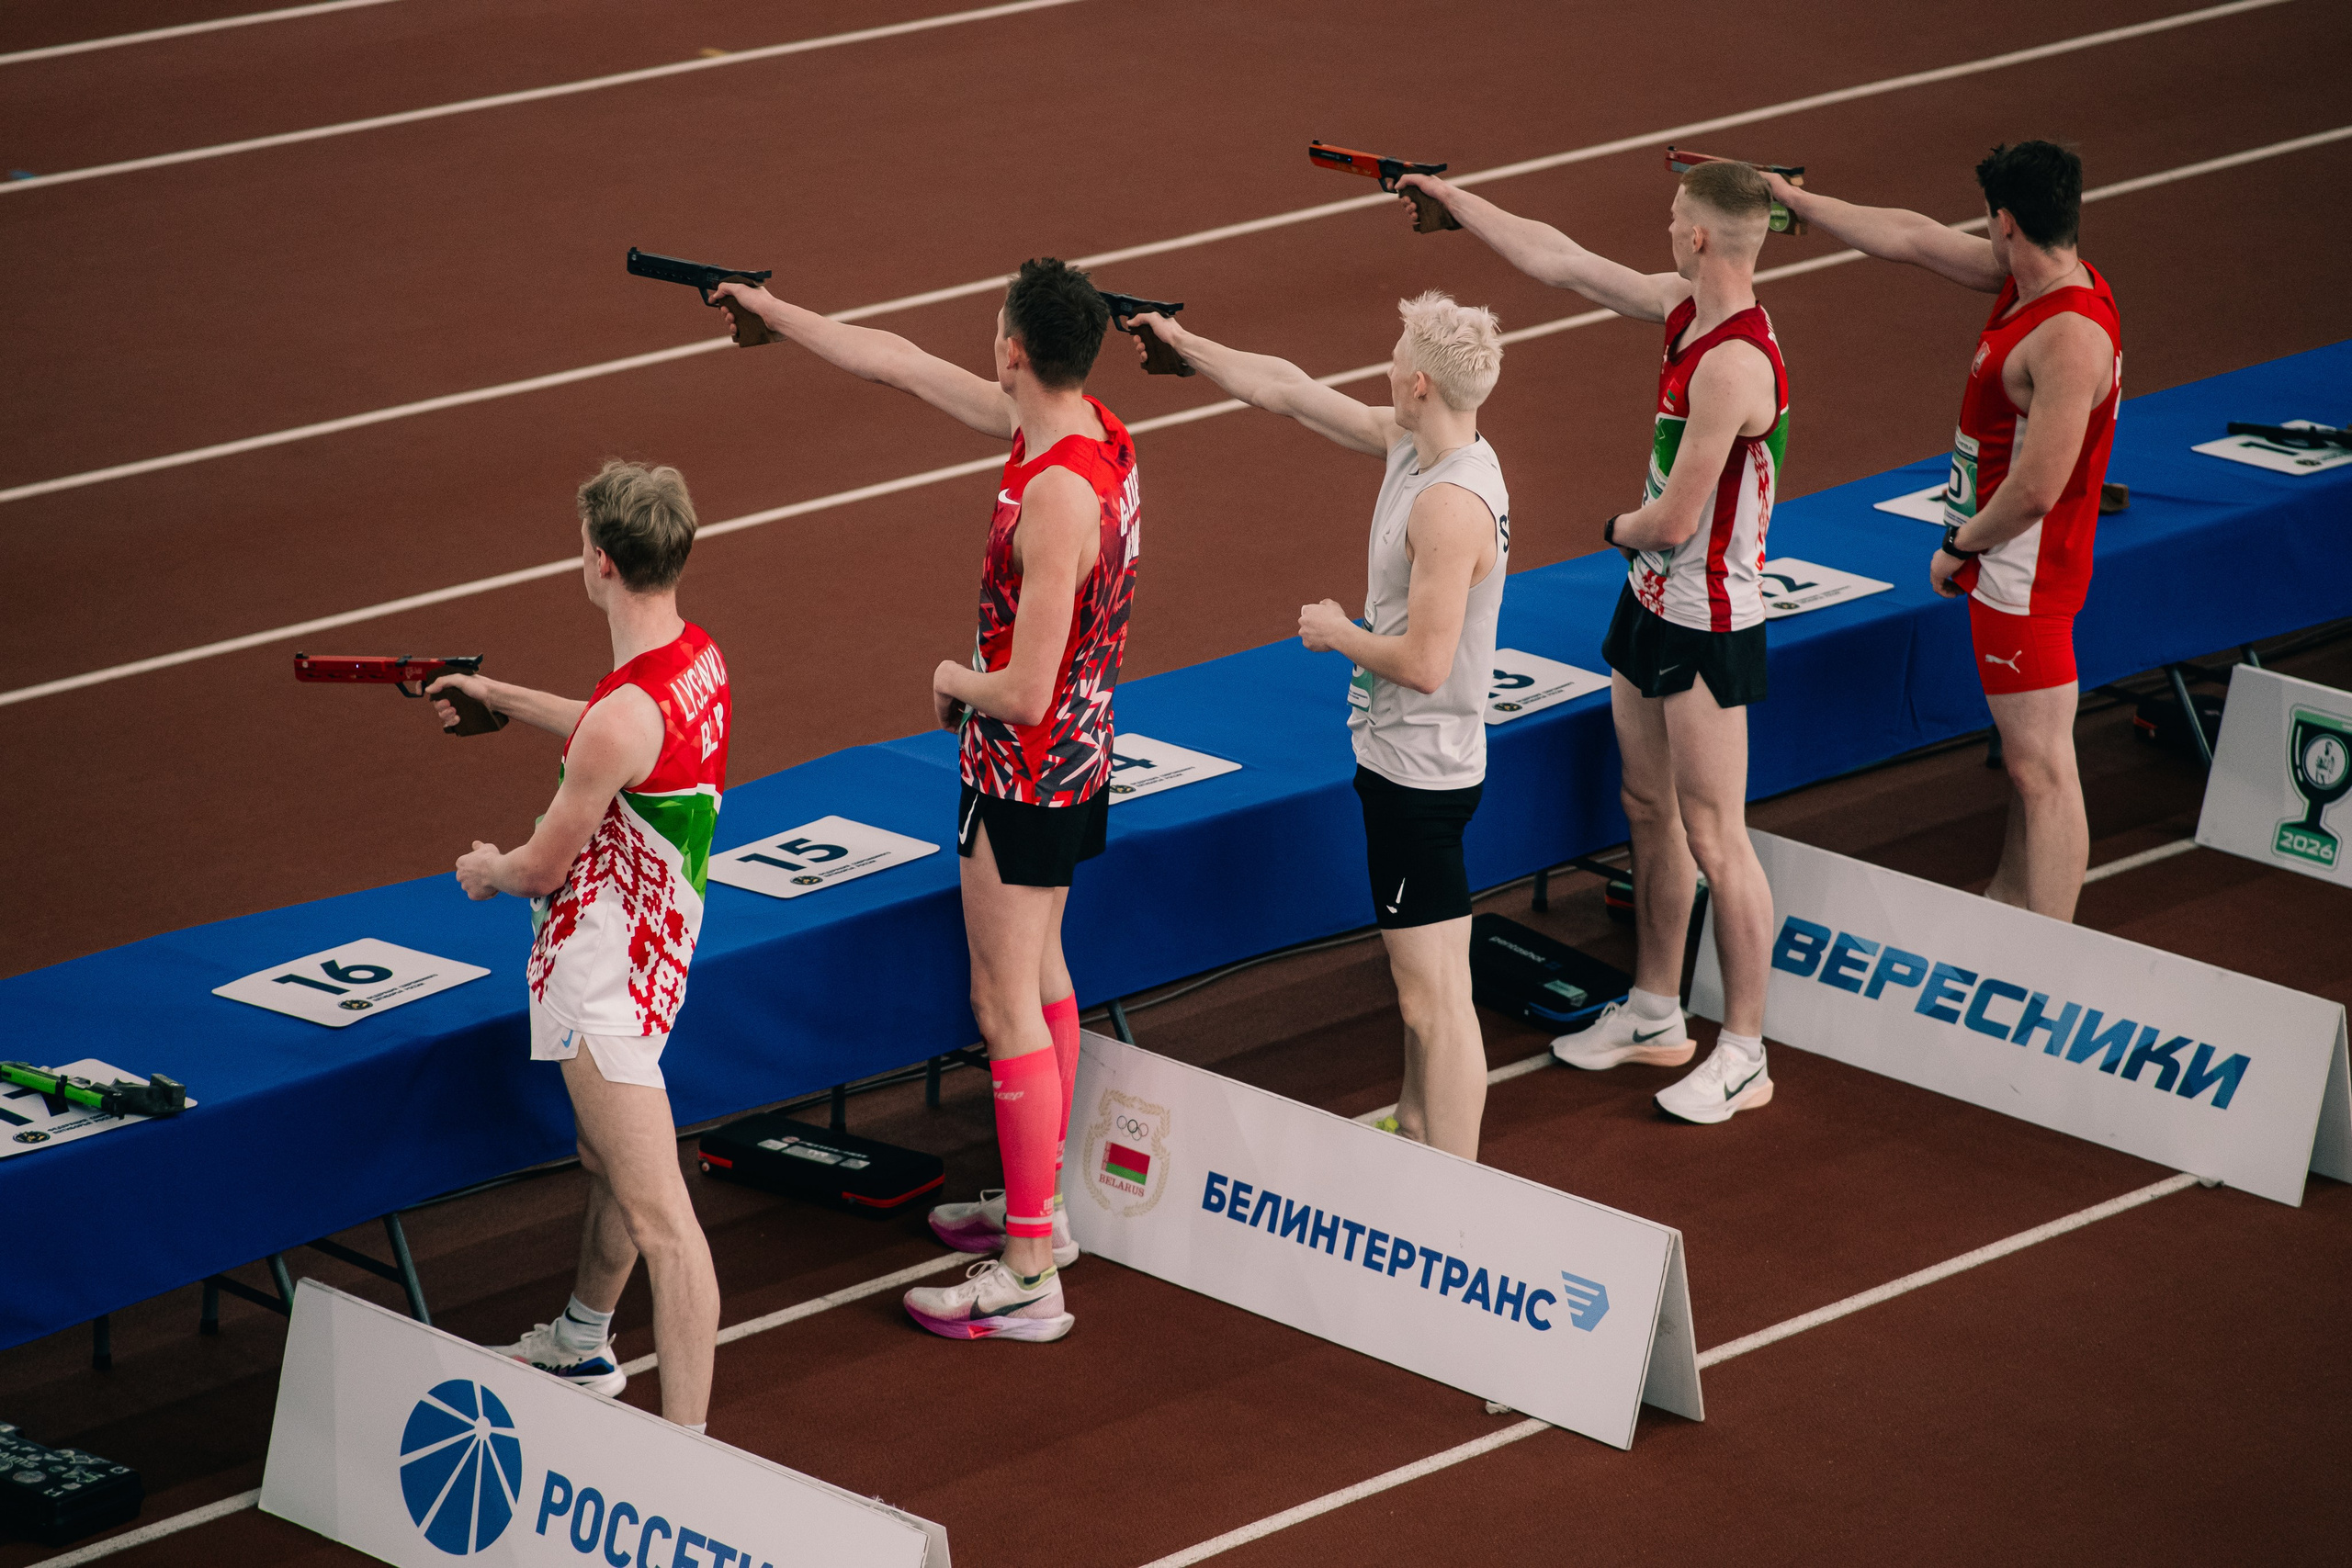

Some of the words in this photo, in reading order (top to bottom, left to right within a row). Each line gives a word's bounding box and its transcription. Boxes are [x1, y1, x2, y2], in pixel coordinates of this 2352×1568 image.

[1758, 573, 1819, 598] 2
[1110, 752, 1158, 780] 4
[735, 838, 849, 872] 15
[2278, 829, 2334, 860] 2026
[271, 959, 393, 996] 16
[1770, 915, 2251, 1110] ВЕРЕСНИКИ
[1099, 1173, 1145, 1198] BELARUS
[1201, 1170, 1559, 1331] БЕЛИНТЕРТРАНС
[536, 1470, 775, 1568] РОССЕТ
